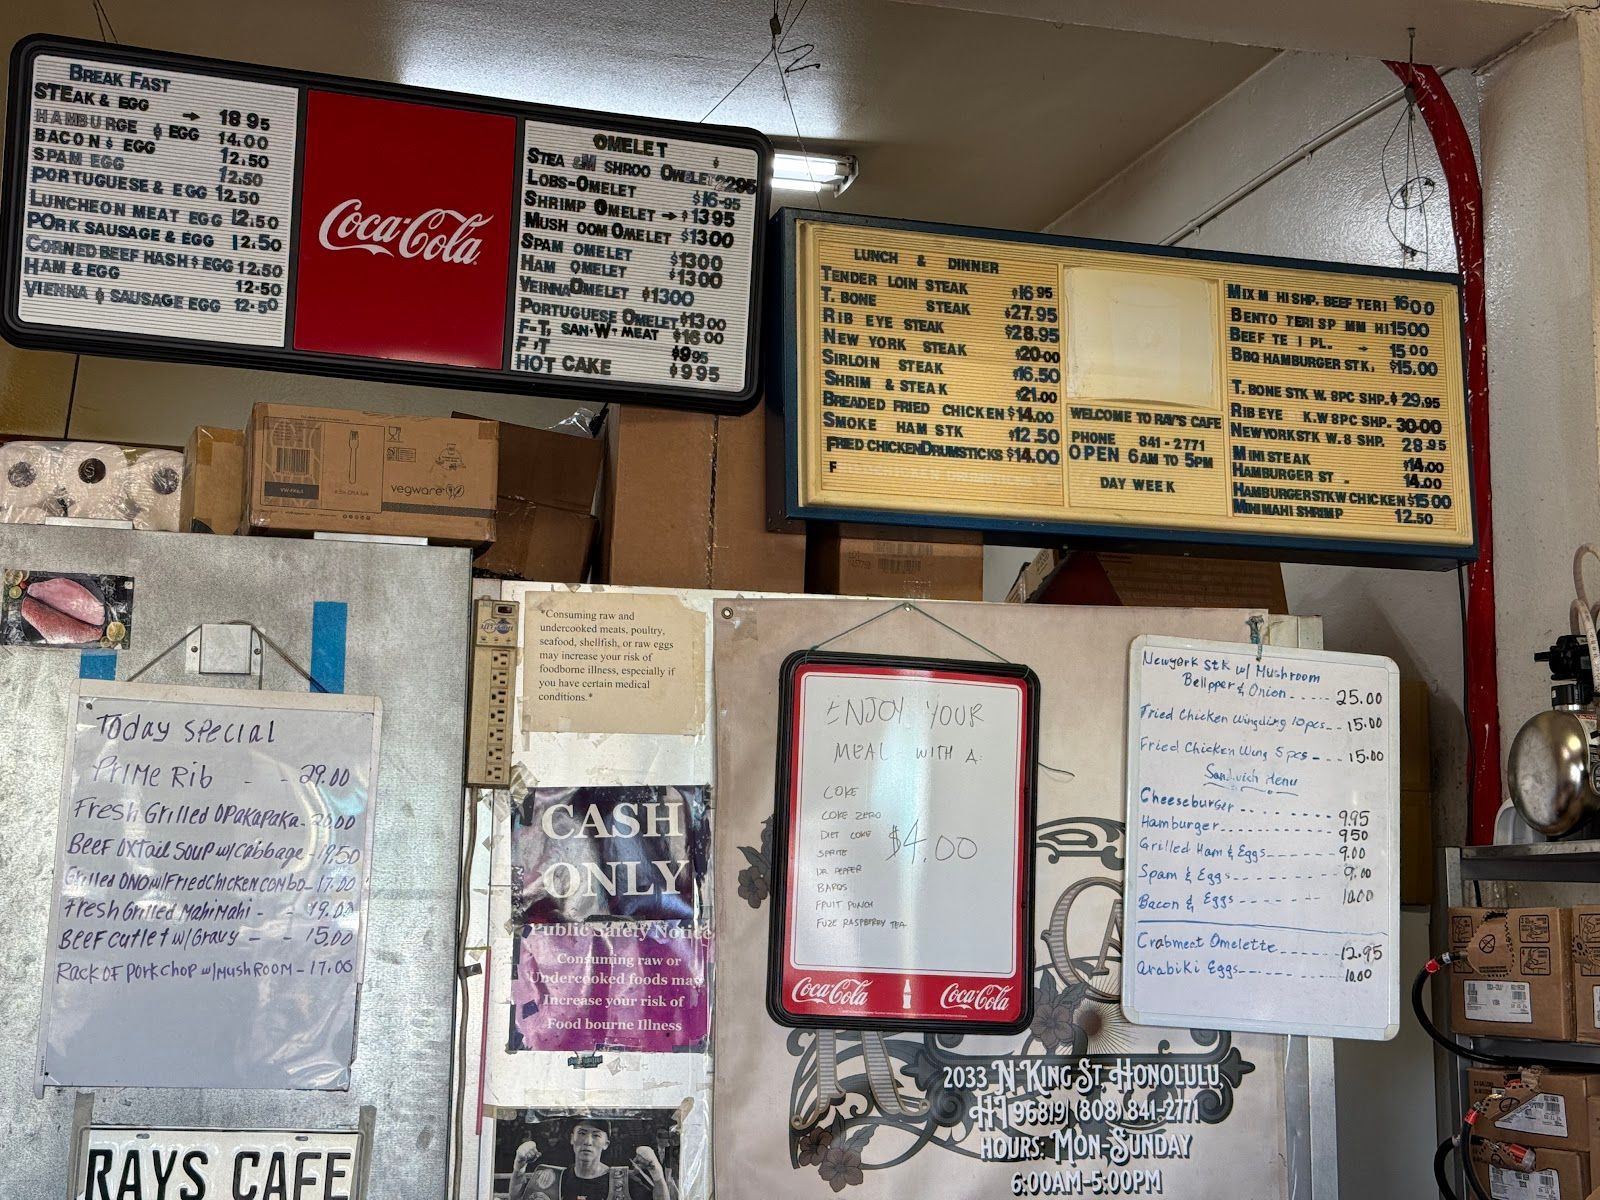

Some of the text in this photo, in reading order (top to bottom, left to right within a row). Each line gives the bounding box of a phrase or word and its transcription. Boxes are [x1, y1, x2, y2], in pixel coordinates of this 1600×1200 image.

[69, 63, 171, 92] BREAK FAST
[34, 82, 149, 111] STEAK EGG
[34, 127, 155, 154] BACON EGG
[169, 124, 200, 140] EGG
[593, 134, 668, 158] OMELET
[33, 147, 124, 170] SPAM EGG
[32, 166, 207, 199] PORTUGUESE EGG
[30, 189, 180, 223] LUNCHEON MEAT
[524, 190, 656, 222] SHRIMP OMELET
[27, 211, 214, 247] PORK SAUSAGE EGG
[319, 198, 494, 266] Coca-Cola
[26, 233, 188, 268] CORNED BEEF HASH
[521, 233, 564, 253] SPAM
[573, 242, 633, 262] OMELET
[24, 257, 120, 279] HAM EGG
[521, 254, 556, 273] HAM
[570, 260, 627, 279] OMELET
[854, 249, 999, 274] LUNCH DINNER
[821, 265, 968, 294] TENDER LOIN STEAK
[24, 280, 220, 312] VIENNA SAUSAGE EGG
[841, 291, 971, 315] BONE STEAK
[1324, 296, 1387, 312] BEEF TERI
[520, 297, 679, 329] PORTUGUESE OMELET
[823, 308, 944, 333] RIB EYE STEAK
[1231, 308, 1313, 328] BENTO TERI
[823, 328, 967, 356] NEW YORK STEAK
[1230, 327, 1265, 343] BEEF
[515, 354, 612, 375] HOT CAKE
[822, 349, 944, 374] SIRLOIN STEAK
[1232, 347, 1341, 370] BBQ HAMBURGER
[825, 370, 948, 395] SHRIM STEAK
[1248, 384, 1309, 400] BONE STK
[823, 391, 885, 411] BREADED
[893, 400, 930, 414] FRIED
[942, 405, 1004, 420] CHICKEN
[1258, 408, 1283, 420] EYE
[823, 412, 964, 438] SMOKE HAM STK
[1070, 407, 1222, 429] WELCOME TO RAY'S CAFE
[1072, 431, 1116, 444] PHONE
[1069, 444, 1213, 468] OPEN 6AM TO 5PM
[1268, 451, 1311, 465] STEAK
[1232, 462, 1313, 481] HAMBURGER
[390, 483, 442, 497] vegware
[1100, 477, 1175, 492] DAY WEEK
[619, 612, 634, 620] and
[562, 652, 598, 661] increase
[600, 654, 620, 662] your
[624, 653, 639, 661] risk
[642, 653, 652, 662] of
[539, 679, 650, 689] you have certain medical
[1256, 666, 1321, 684] Mushroom
[1248, 683, 1383, 706] Onion 25.00
[826, 696, 984, 728] ENJOY YOUR
[96, 713, 171, 744] Today
[1347, 718, 1383, 732] 15.00
[834, 742, 953, 764] MEAL WITH
[823, 786, 860, 799] COKE
[1140, 787, 1234, 812] Cheeseburger
[541, 802, 683, 840] CASH
[1141, 814, 1221, 838] Hamburger
[817, 849, 848, 858] SPRITE
[886, 819, 978, 864] $4.00
[1139, 838, 1192, 852] Grilled
[543, 860, 689, 899] ONLY
[1138, 865, 1231, 885] Spam Eggs
[1138, 893, 1180, 911] Bacon
[1210, 933, 1383, 961] Omelette 12.95
[557, 953, 682, 967] Consuming raw or
[528, 972, 668, 986] Undercooked foods
[543, 994, 685, 1009] Increase your risk of
[791, 976, 873, 1007] Coca-Cola
[940, 982, 1014, 1011] Coca-Cola
[547, 1018, 682, 1032] Food bourne Illness
[943, 1065, 988, 1089] 2033
[1019, 1060, 1071, 1097] KING
[1074, 1098, 1201, 1125] (808) 841-2771
[980, 1130, 1194, 1165] HOURS: MON-SUNDAY
[84, 1150, 352, 1200] RAYS CAFE
[1010, 1170, 1164, 1197] 6:00AM-5:00PM
